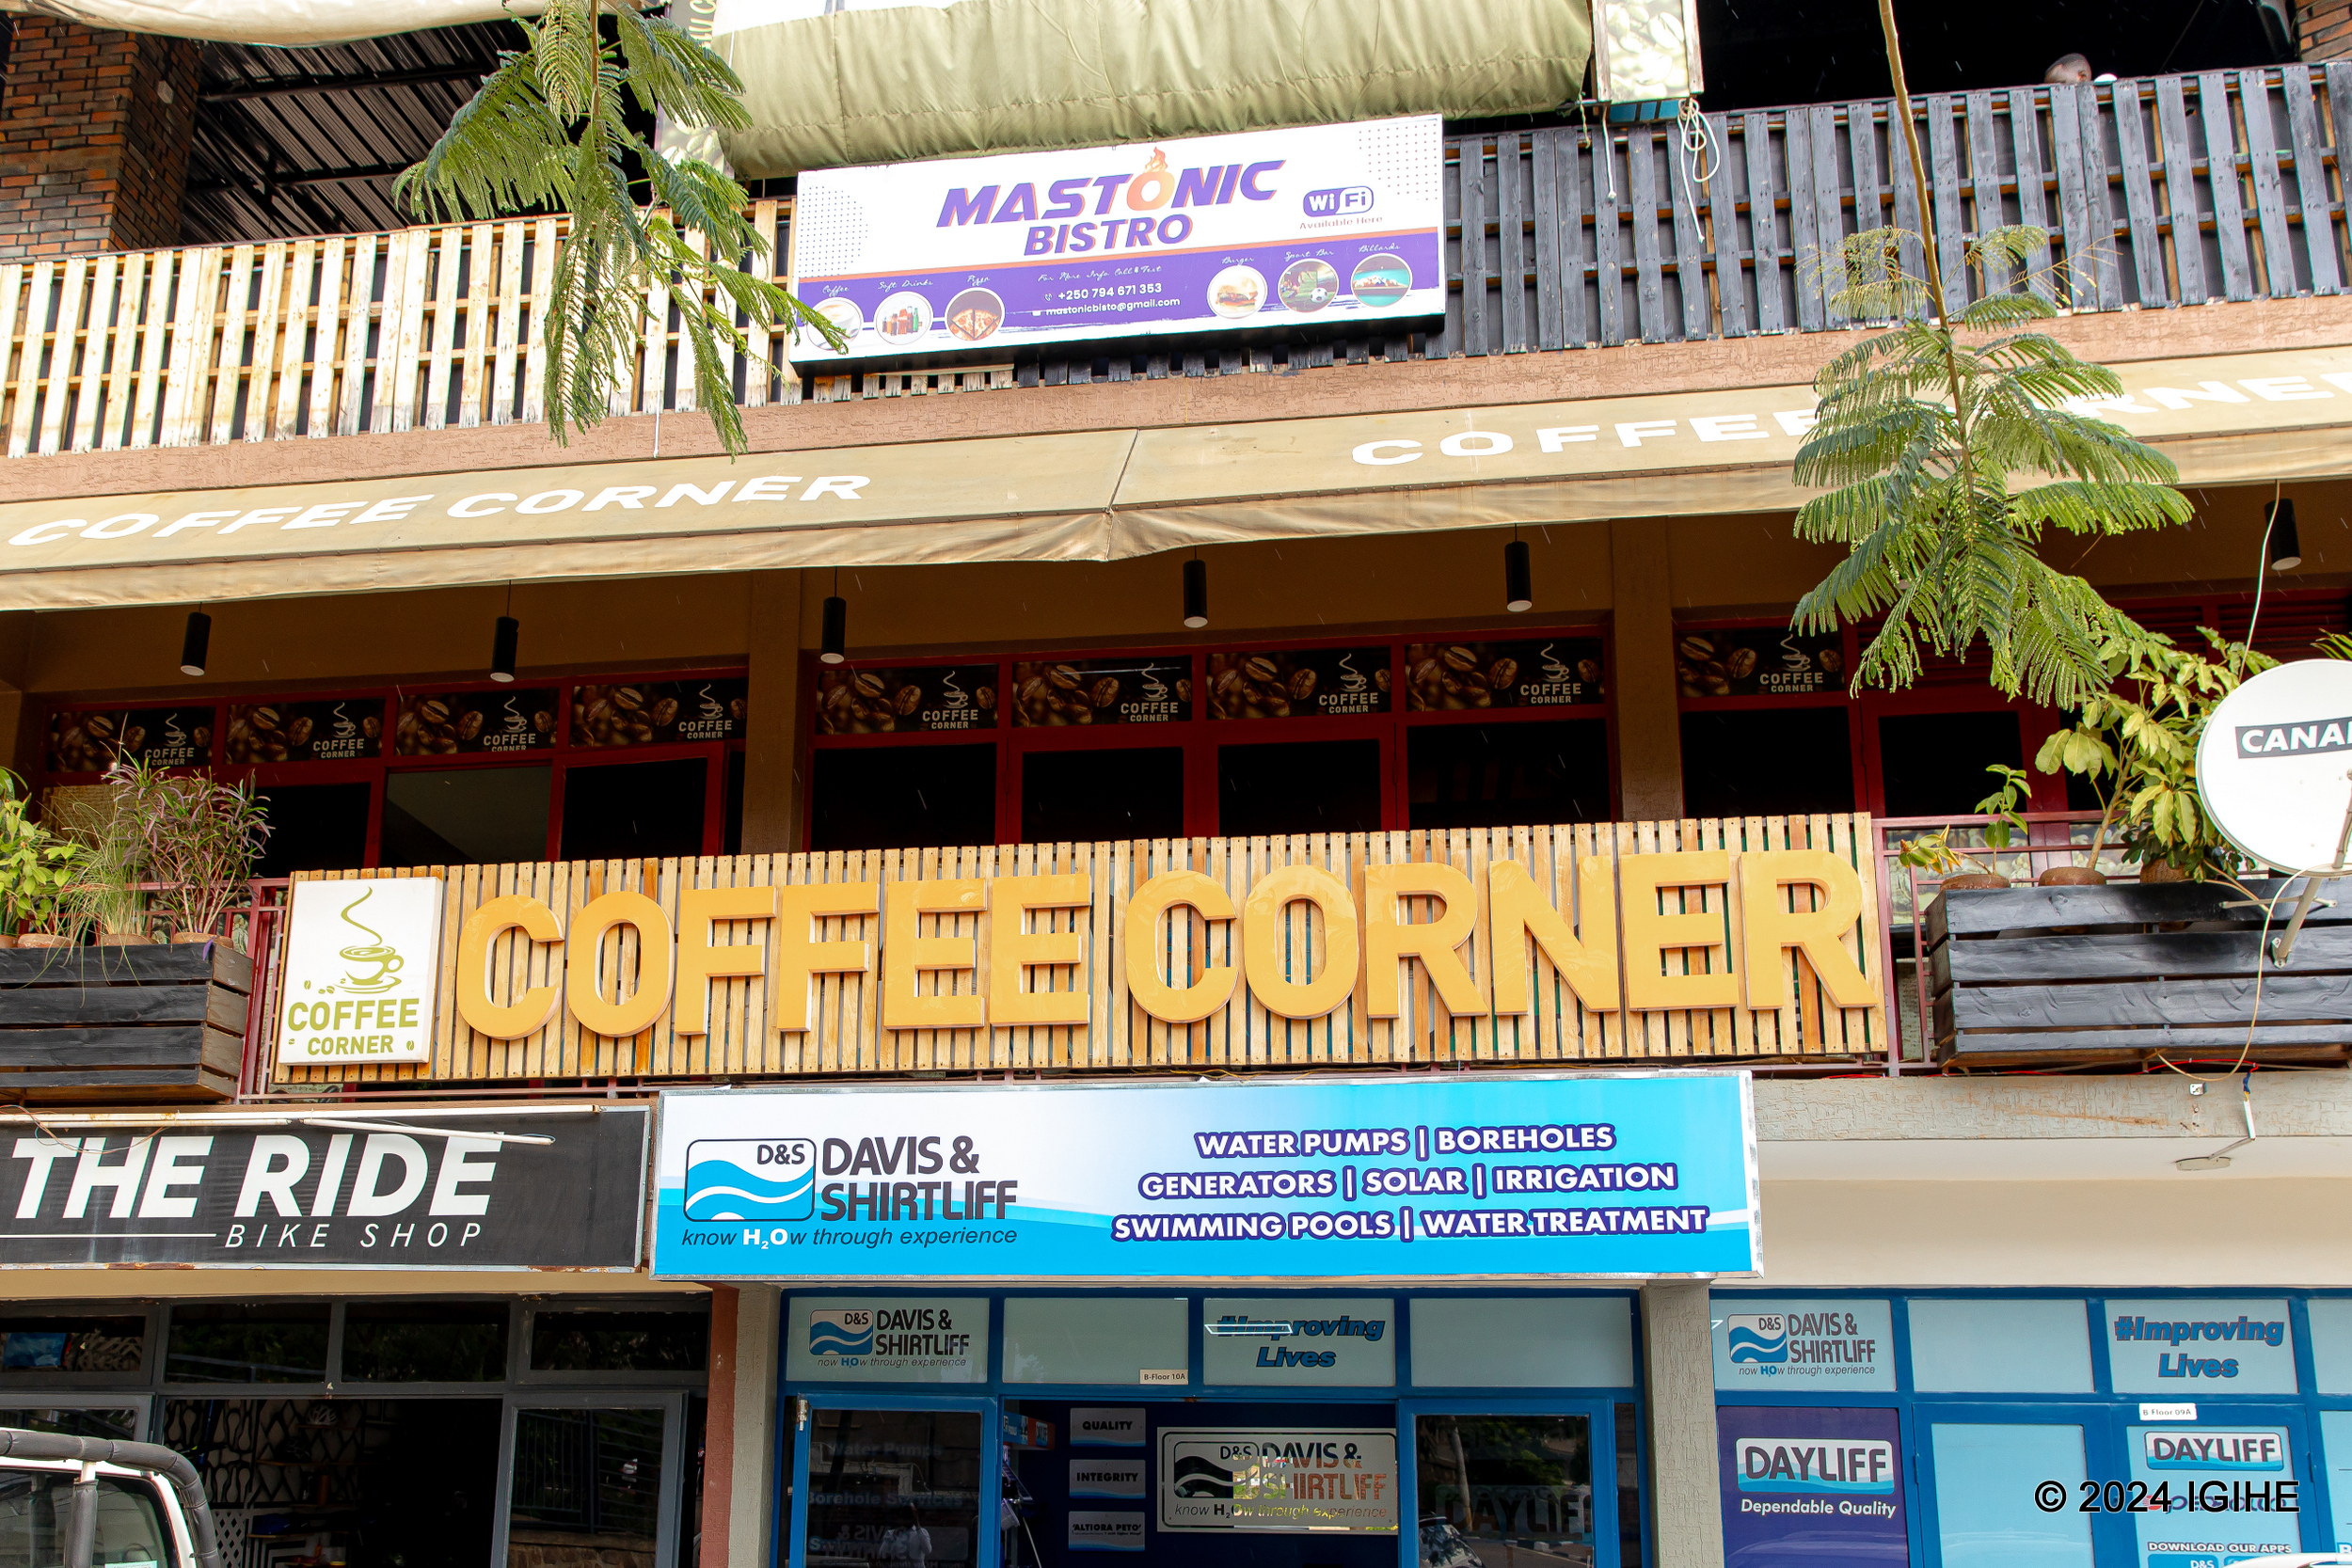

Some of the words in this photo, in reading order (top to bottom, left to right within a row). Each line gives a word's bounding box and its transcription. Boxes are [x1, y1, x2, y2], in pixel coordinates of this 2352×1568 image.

[936, 159, 1287, 228] MASTONIC
[1299, 217, 1353, 230] Available
[1356, 215, 1383, 224] Here
[1024, 214, 1193, 256] BISTRO
[1221, 256, 1255, 266] Burger
[1284, 250, 1311, 262] Sport
[1315, 248, 1334, 257] Bar
[1038, 274, 1055, 282] For
[1058, 271, 1081, 281] More
[1087, 270, 1110, 281] Info
[1114, 266, 1133, 277] Call
[822, 285, 850, 297] Coffee
[878, 280, 898, 293] Soft
[901, 278, 933, 288] Drinks
[1057, 288, 1089, 301] +250
[1091, 286, 1115, 298] 794
[1117, 284, 1136, 296] 671
[1139, 282, 1162, 294] 353
[1045, 297, 1181, 316] mastonicbisto@gmail.com
[8, 494, 435, 546] COFFEE
[447, 475, 871, 518] CORNER
[1759, 672, 1823, 685] COFFEE
[1519, 683, 1581, 696] COFFEE
[1771, 684, 1814, 692] CORNER
[1318, 692, 1379, 705] COFFEE
[1531, 695, 1572, 704] CORNER
[922, 709, 978, 721] COFFEE
[1120, 702, 1179, 714] COFFEE
[1328, 705, 1369, 714] CORNER
[678, 720, 733, 732] COFFEE
[930, 721, 969, 730] CORNER
[1130, 714, 1168, 722] CORNER
[483, 734, 536, 746] COFFEE
[687, 731, 723, 739] CORNER
[2241, 721, 2352, 753] CANA
[145, 747, 195, 759] COFFEE
[313, 738, 365, 752] COFFEE
[321, 750, 356, 759] CORNER
[455, 873, 1092, 1040] COFFEE
[1126, 848, 1878, 1024] CORNER
[288, 998, 420, 1032] COFFEE
[307, 1035, 393, 1056] CORNER
[1197, 1132, 1299, 1158] WATER
[1304, 1129, 1407, 1157] PUMPS
[1438, 1125, 1615, 1153] BOREHOLES
[755, 1143, 806, 1165] D&S
[821, 1135, 944, 1176] DAVIS
[948, 1134, 979, 1174] &
[11, 1135, 215, 1219] THE
[233, 1132, 504, 1217] RIDE
[1141, 1171, 1334, 1198] GENERATORS
[1361, 1168, 1465, 1196] SOLAR
[1493, 1164, 1677, 1193] IRRIGATION
[820, 1180, 1018, 1222] SHIRTLIFF
[1114, 1213, 1284, 1242] SWIMMING
[1290, 1212, 1391, 1239] POOLS
[1422, 1210, 1533, 1237] WATER
[1534, 1208, 1709, 1235] TREATMENT
[224, 1223, 330, 1249] BIKE
[359, 1222, 482, 1249] SHOP
[681, 1228, 738, 1246] know
[812, 1227, 893, 1249] through
[899, 1227, 1018, 1247] experience
[844, 1312, 869, 1324] D&S
[876, 1309, 934, 1331] DAVIS
[938, 1308, 952, 1330] &
[1758, 1317, 1781, 1330] D&S
[1788, 1313, 1842, 1337] DAVIS
[1844, 1312, 1858, 1336] &
[2114, 1315, 2285, 1347] #Improving
[875, 1334, 970, 1355] SHIRTLIFF
[1789, 1339, 1876, 1363] SHIRTLIFF
[870, 1357, 908, 1369] through
[911, 1358, 966, 1369] experience
[1256, 1346, 1336, 1367] Lives
[1739, 1367, 1757, 1375] now
[1788, 1365, 1822, 1377] through
[1824, 1366, 1875, 1377] experience
[2157, 1353, 2239, 1379] Lives
[1082, 1420, 1133, 1431] QUALITY
[1219, 1445, 1252, 1460] D&S
[1262, 1442, 1337, 1468] DAVIS
[1343, 1442, 1362, 1469] &
[2152, 1437, 2277, 1464] DAYLIFF
[1743, 1446, 1887, 1483] DAYLIFF
[1076, 1472, 1138, 1481] INTEGRITY
[1262, 1473, 1387, 1499] SHIRTLIFF
[1175, 1503, 1209, 1516] know
[1258, 1504, 1309, 1520] through
[1313, 1505, 1387, 1520] experience
[1740, 1499, 1834, 1517] Dependable
[1837, 1500, 1897, 1521] Quality
[2148, 1541, 2225, 1552] DOWNLOAD
[2227, 1543, 2257, 1553] OUR
[2259, 1543, 2292, 1553] APPS
